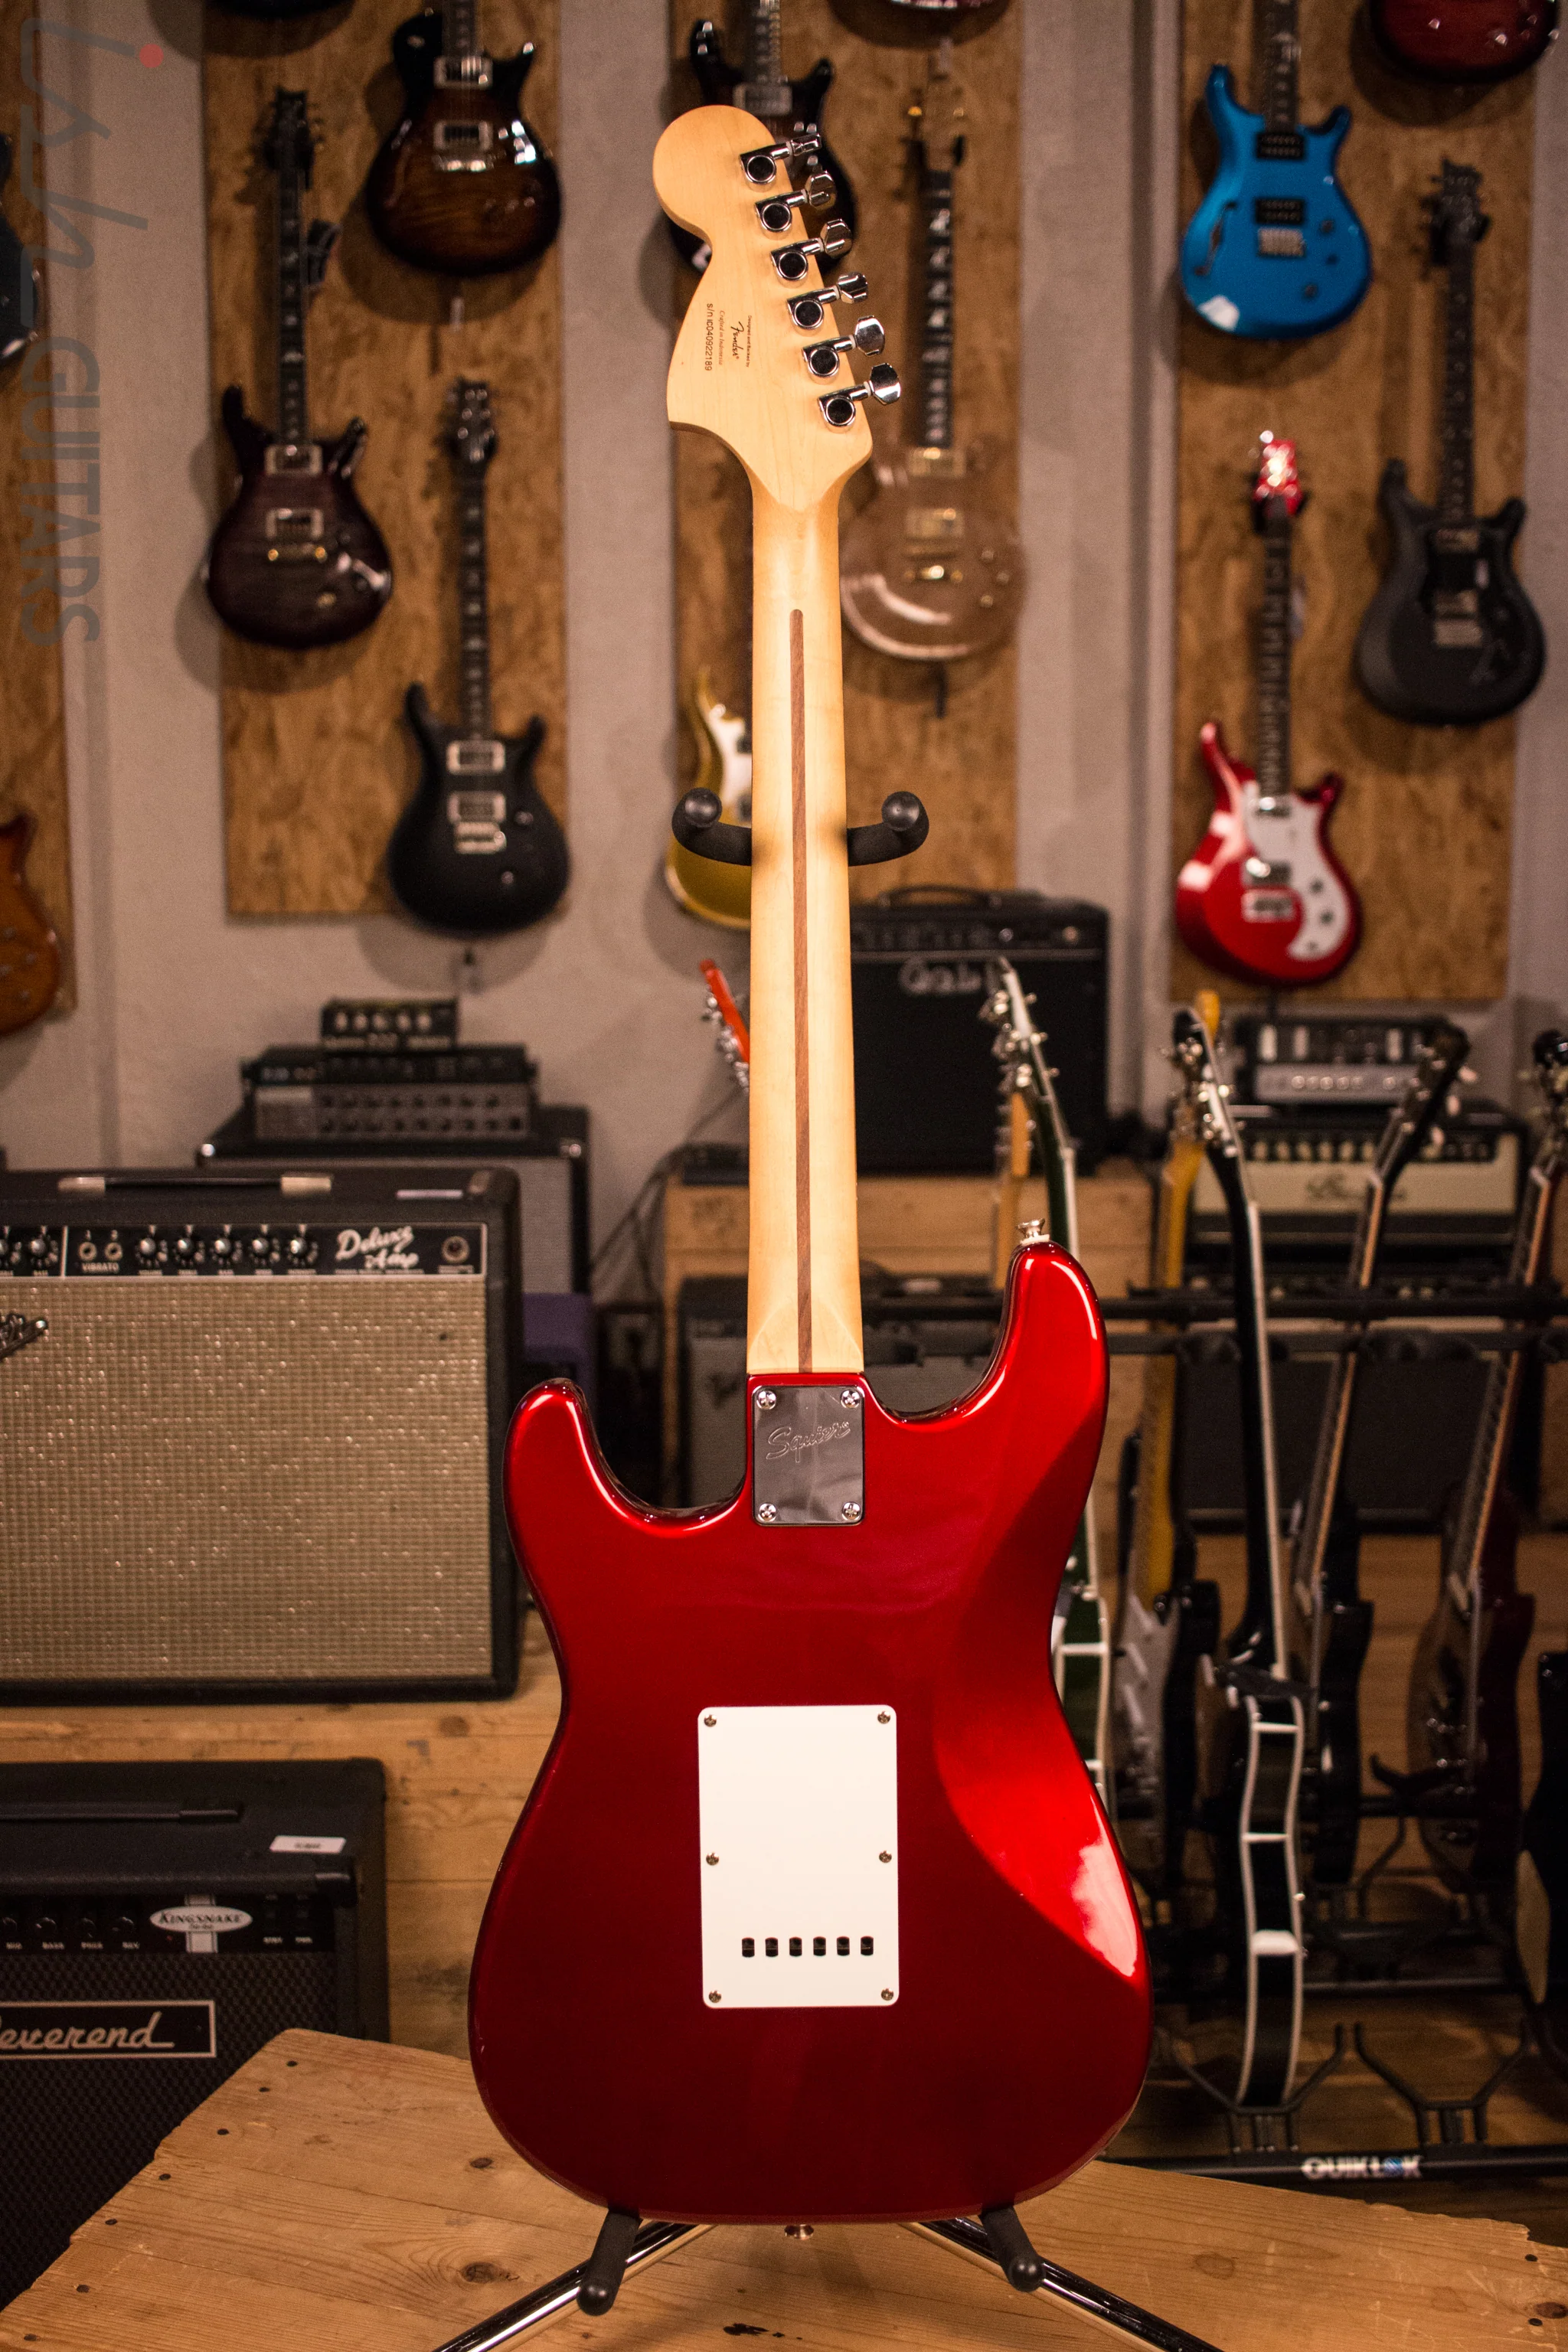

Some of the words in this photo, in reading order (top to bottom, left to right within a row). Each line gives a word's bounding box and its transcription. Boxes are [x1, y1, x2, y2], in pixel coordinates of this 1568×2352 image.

[81, 1263, 119, 1272] VIBRATO
[158, 1913, 242, 1924] KINGSNAKE
[0, 2011, 175, 2050] everend
